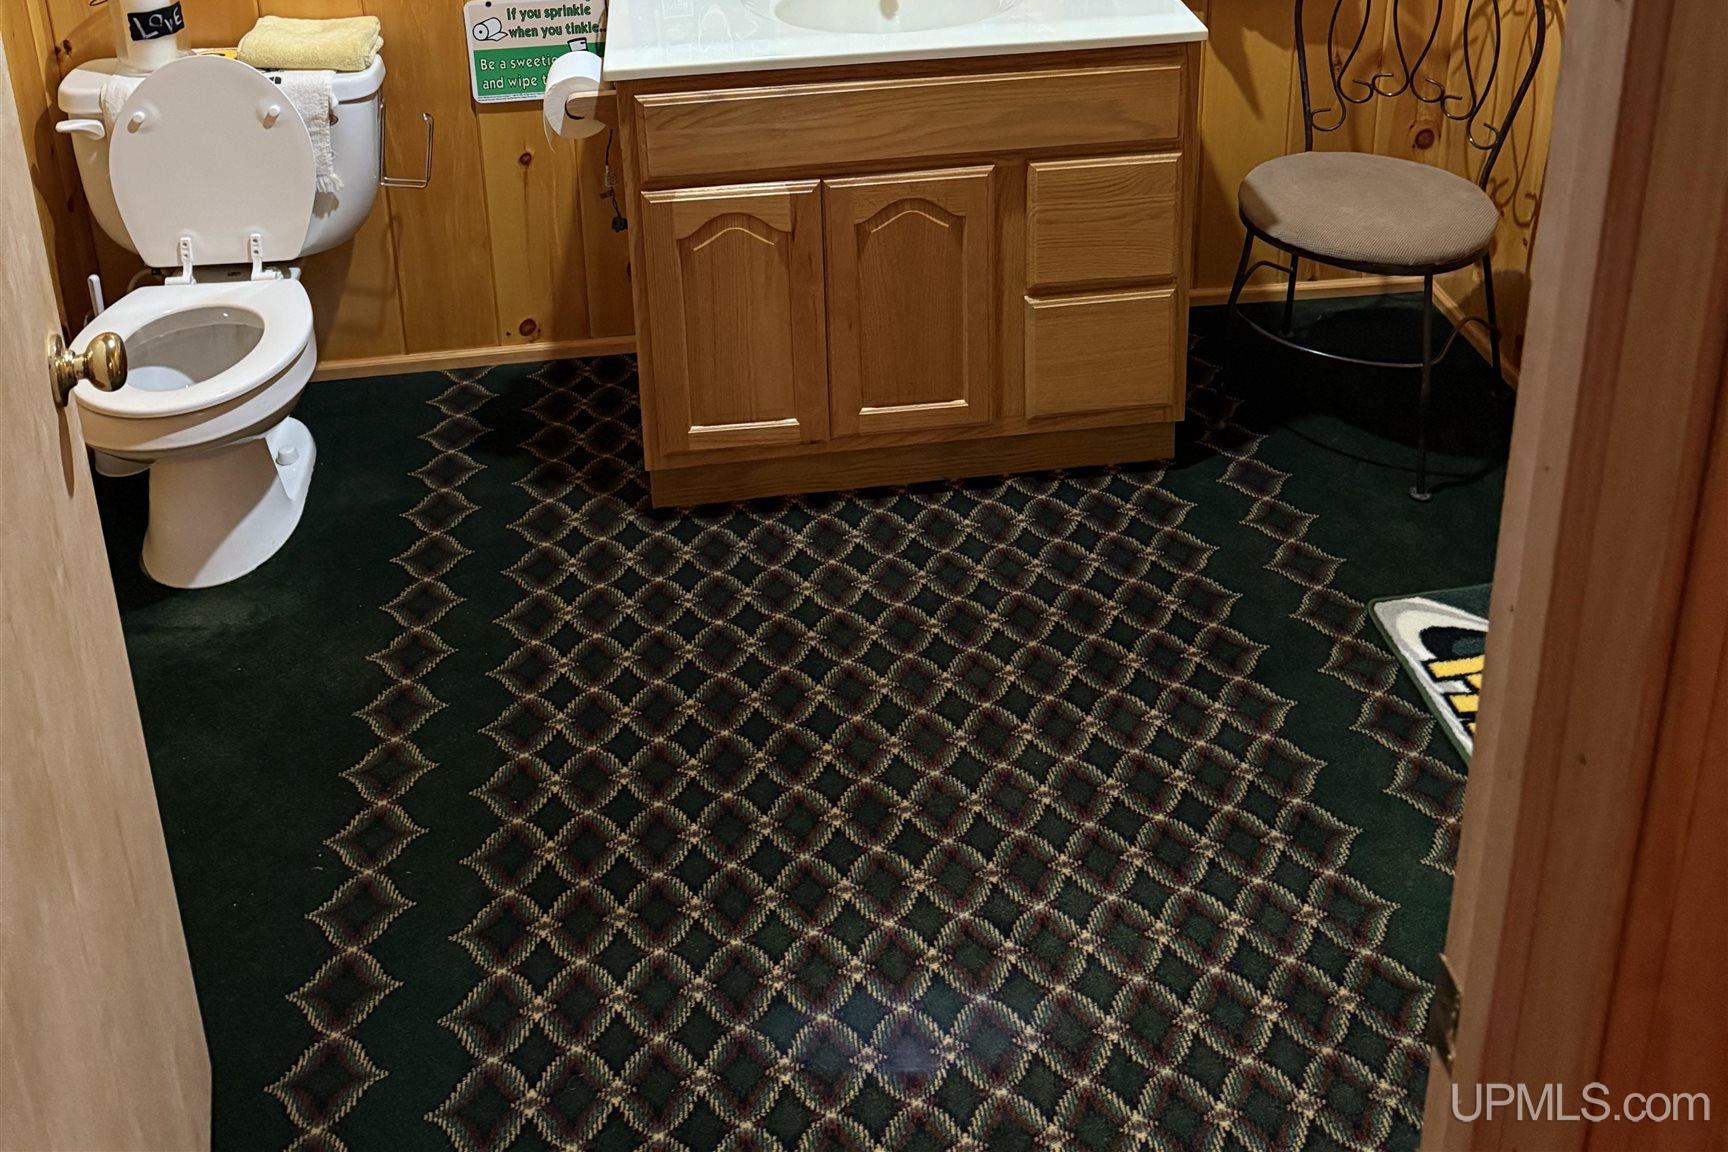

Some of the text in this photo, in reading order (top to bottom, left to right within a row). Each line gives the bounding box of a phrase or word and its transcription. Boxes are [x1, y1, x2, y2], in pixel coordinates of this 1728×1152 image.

[506, 4, 591, 22] If you sprinkle
[508, 26, 538, 38] when
[541, 25, 562, 38] you
[480, 59, 495, 70] Be
[500, 60, 506, 68] a
[483, 78, 504, 90] and
[508, 76, 538, 89] wipe
